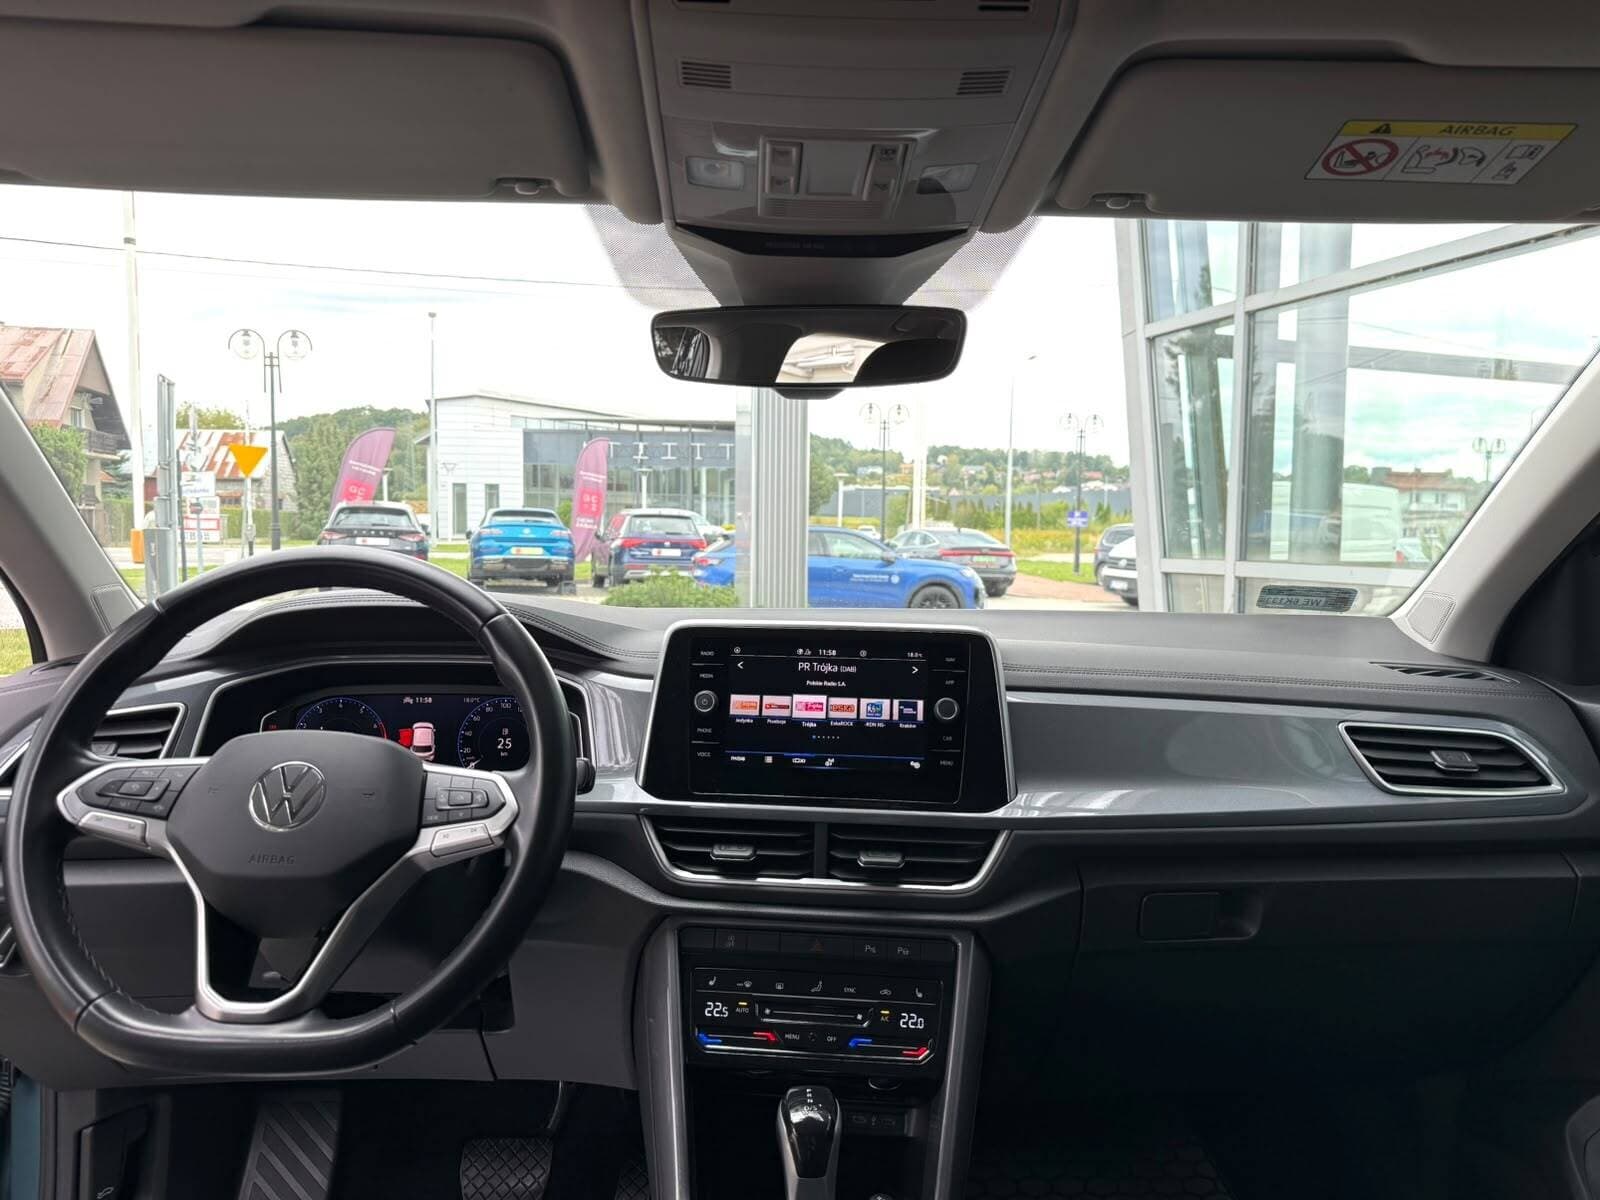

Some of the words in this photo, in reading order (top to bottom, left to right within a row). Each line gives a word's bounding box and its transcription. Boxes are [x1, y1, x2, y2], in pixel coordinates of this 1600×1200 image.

[1438, 124, 1518, 136] AIRBAG
[818, 648, 837, 656] 11:58
[798, 662, 810, 672] PR
[812, 660, 838, 674] Trójka
[840, 664, 857, 673] (DAB)
[801, 720, 817, 728] Trójka
[497, 737, 512, 749] 25
[247, 853, 295, 865] AIRBAG
[704, 1001, 729, 1018] 22.5
[900, 1013, 924, 1029] 22.0
[785, 1033, 800, 1041] MENU
